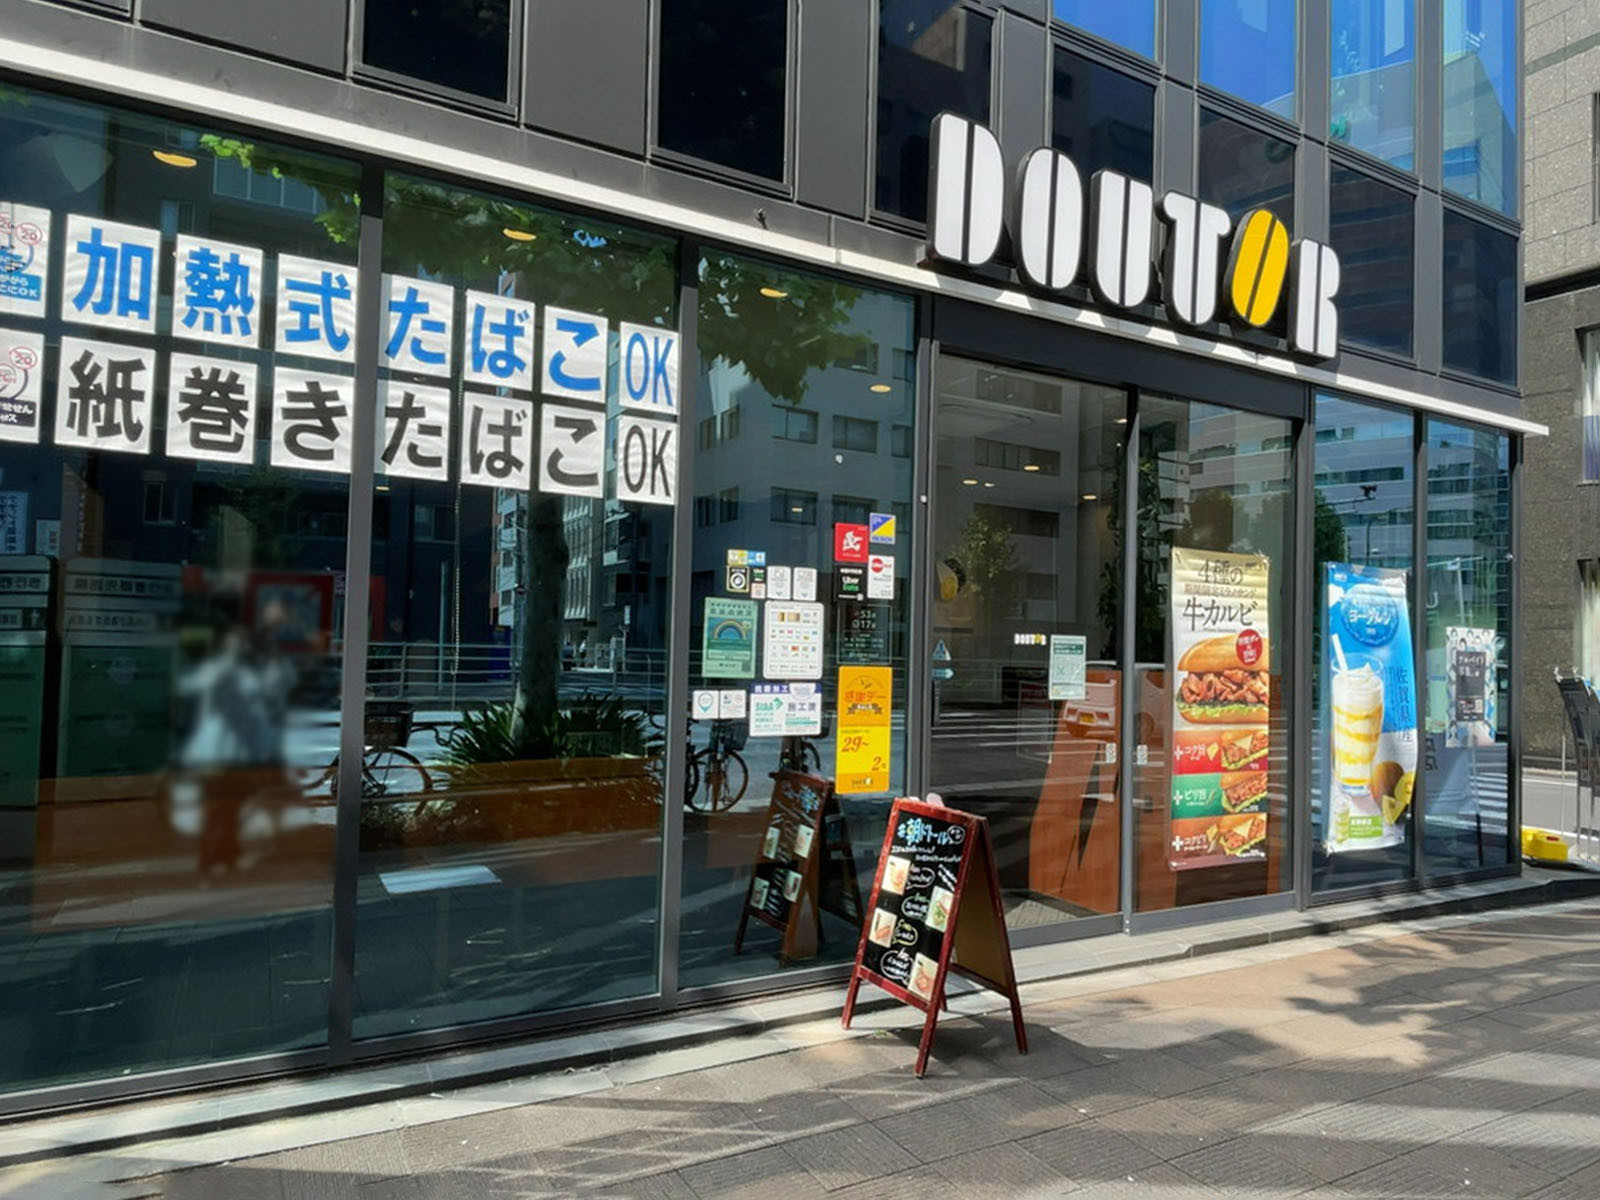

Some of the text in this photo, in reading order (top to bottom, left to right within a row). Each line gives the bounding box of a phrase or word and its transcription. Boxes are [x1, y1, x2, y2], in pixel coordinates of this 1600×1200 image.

[930, 112, 1341, 359] DOUTOR
[1182, 597, 1258, 632] 牛カルビ
